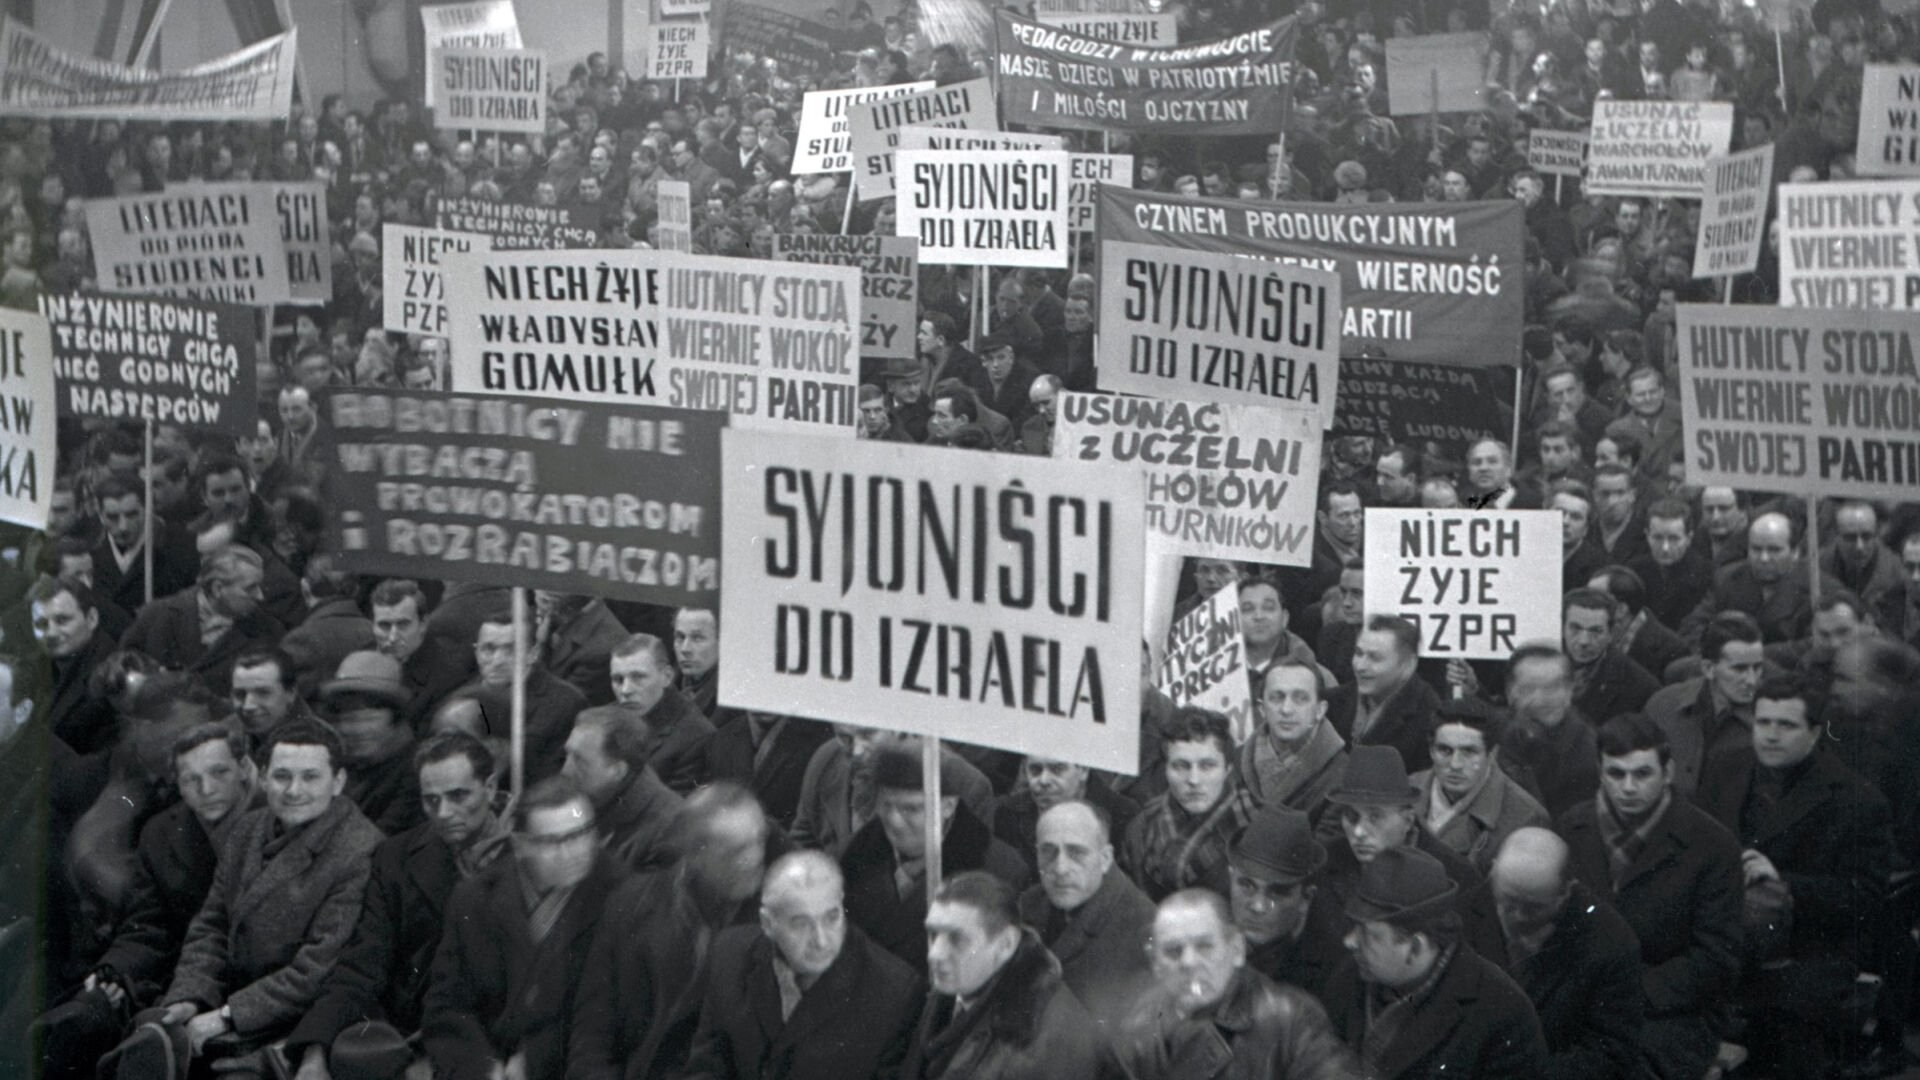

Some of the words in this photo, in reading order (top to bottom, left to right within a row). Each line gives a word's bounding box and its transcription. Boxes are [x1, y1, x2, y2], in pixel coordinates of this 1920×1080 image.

[658, 27, 696, 42] NIECH
[1012, 23, 1123, 60] PEDAGODZY
[1122, 18, 1159, 42] ŻYJE
[656, 60, 694, 76] PZPR
[1000, 53, 1053, 80] NASZE
[1058, 63, 1115, 87] DZIECI
[1122, 68, 1140, 87] W
[872, 88, 970, 131] LITERACI
[1031, 90, 1039, 111] I
[1054, 91, 1127, 119] MIŁOŚCI
[1145, 99, 1249, 122] OJCZYZNY
[1594, 144, 1712, 158] WARCHOŁÓW
[1609, 122, 1701, 140] UCZELNI
[914, 158, 1057, 212] SYJONIŚCI
[119, 194, 249, 234] LITERACI
[437, 199, 570, 224] INŻYNIEROWIE
[451, 214, 549, 235] TECHNICY
[1135, 204, 1228, 236] CZYNEM
[1246, 210, 1457, 247] PRODUKCYJNYM
[1788, 192, 1903, 228] HUTNICY
[141, 238, 169, 255] DO
[779, 235, 882, 254] BANKRUCI
[920, 217, 954, 248] DO
[964, 218, 1057, 250] IZRAELA
[1791, 235, 1907, 269] WIERNIE
[114, 253, 264, 289] STUDENCI
[484, 265, 588, 301] NIECH
[596, 262, 659, 309] ŻYJE
[1357, 254, 1501, 295] WIERNOŚĆ
[1791, 275, 1896, 308] SWOJEJ
[37, 290, 219, 340] INŻYNIEROWIE
[667, 267, 765, 316] HUTNICY
[774, 276, 851, 332] STOJĄ
[1125, 258, 1326, 350] SYJONIŚCI
[1339, 306, 1412, 340] ARTII
[57, 326, 170, 360] TECHNICY
[184, 339, 239, 378] CHCĄ
[667, 317, 760, 367] WIERNIE
[770, 326, 852, 375] WOKÓŁ
[1690, 325, 1810, 372] HUTNICY
[119, 357, 230, 395] GODNYCH
[1130, 335, 1177, 378] DO
[1191, 344, 1320, 404] IZRAELA
[669, 367, 758, 415] SWOJEJ
[768, 377, 855, 426] PARTII
[1064, 395, 1221, 436] USUNĄĆ
[1693, 377, 1811, 425] WIERNIE
[330, 394, 588, 445] ROBOTNICY
[607, 415, 686, 456] NIE
[337, 443, 538, 491] WYBACZĄ
[1111, 431, 1303, 476] UCZELNI
[1696, 429, 1807, 477] SWOJEJ
[375, 481, 705, 538] PROWOKATOROM
[385, 518, 720, 593] ROZRABIACZOM
[765, 465, 1112, 623] SYJONIŚCI
[1399, 560, 1500, 605] ŻYJE
[774, 604, 855, 682] DO
[879, 616, 1107, 725] IZRAELA
